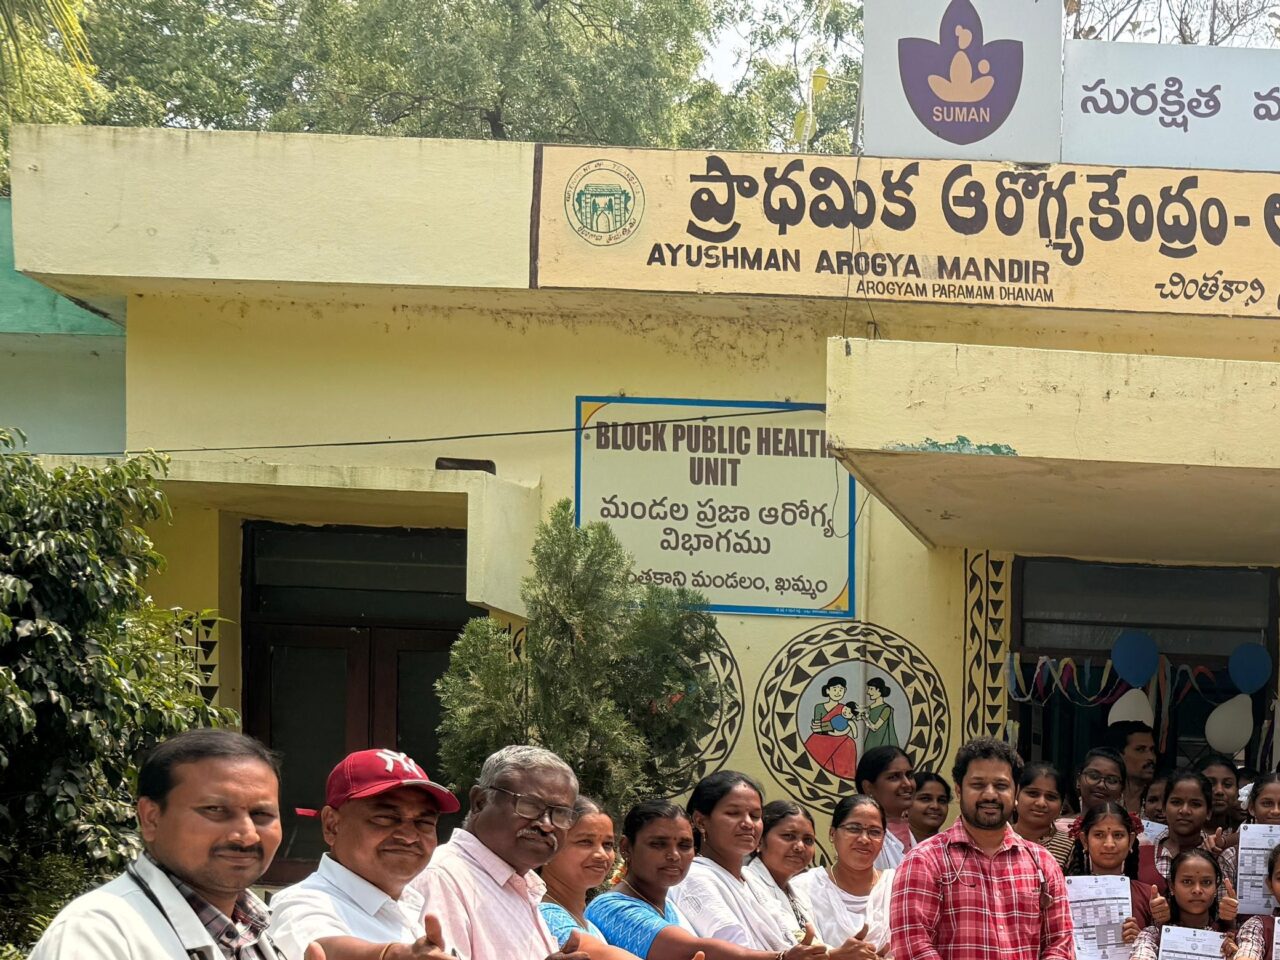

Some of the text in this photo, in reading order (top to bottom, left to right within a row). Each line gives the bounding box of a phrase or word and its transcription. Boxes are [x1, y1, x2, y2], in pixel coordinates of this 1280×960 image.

[932, 106, 990, 122] SUMAN
[1081, 77, 1221, 133] సురక్షిత
[646, 243, 1050, 285] AYUSHMAN AROGYA MANDIR
[856, 280, 1055, 302] AROGYAM PARAMAM DHANAM
[1155, 270, 1265, 307] చింతకాని
[595, 421, 668, 452] BLOCK
[672, 424, 751, 455] PUBLIC
[689, 456, 741, 486] UNIT
[600, 494, 835, 538] మండల ప్రజా ఆరోగ్య
[660, 527, 771, 557] విభాగము
[691, 571, 770, 593] మండలం,
[774, 575, 828, 600] ఖమ్మం
[376, 749, 423, 778] NY
